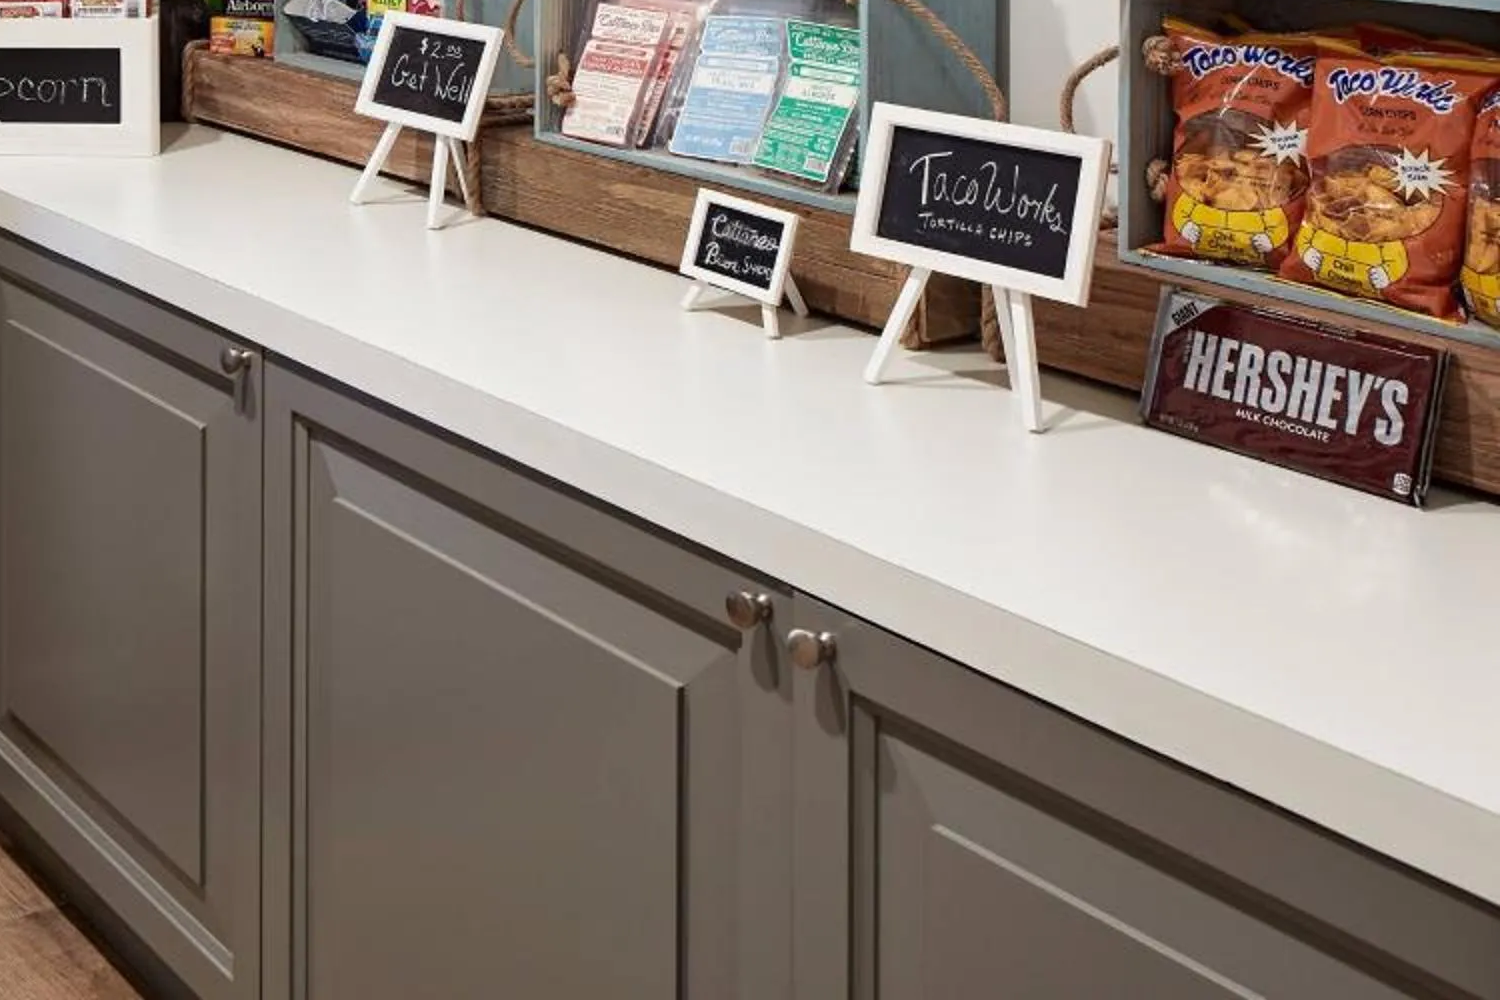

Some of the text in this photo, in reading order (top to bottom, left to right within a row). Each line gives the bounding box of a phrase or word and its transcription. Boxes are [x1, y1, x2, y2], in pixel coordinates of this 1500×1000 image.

[391, 53, 474, 105] Get Well
[1180, 46, 1239, 78] Taco
[1328, 68, 1377, 102] Taco
[1379, 68, 1456, 114] Works
[917, 211, 1033, 247] TORTILLA CHIPS
[1182, 329, 1410, 447] HERSHEY'S
[1235, 407, 1332, 444] MILK CHOCOLATE
